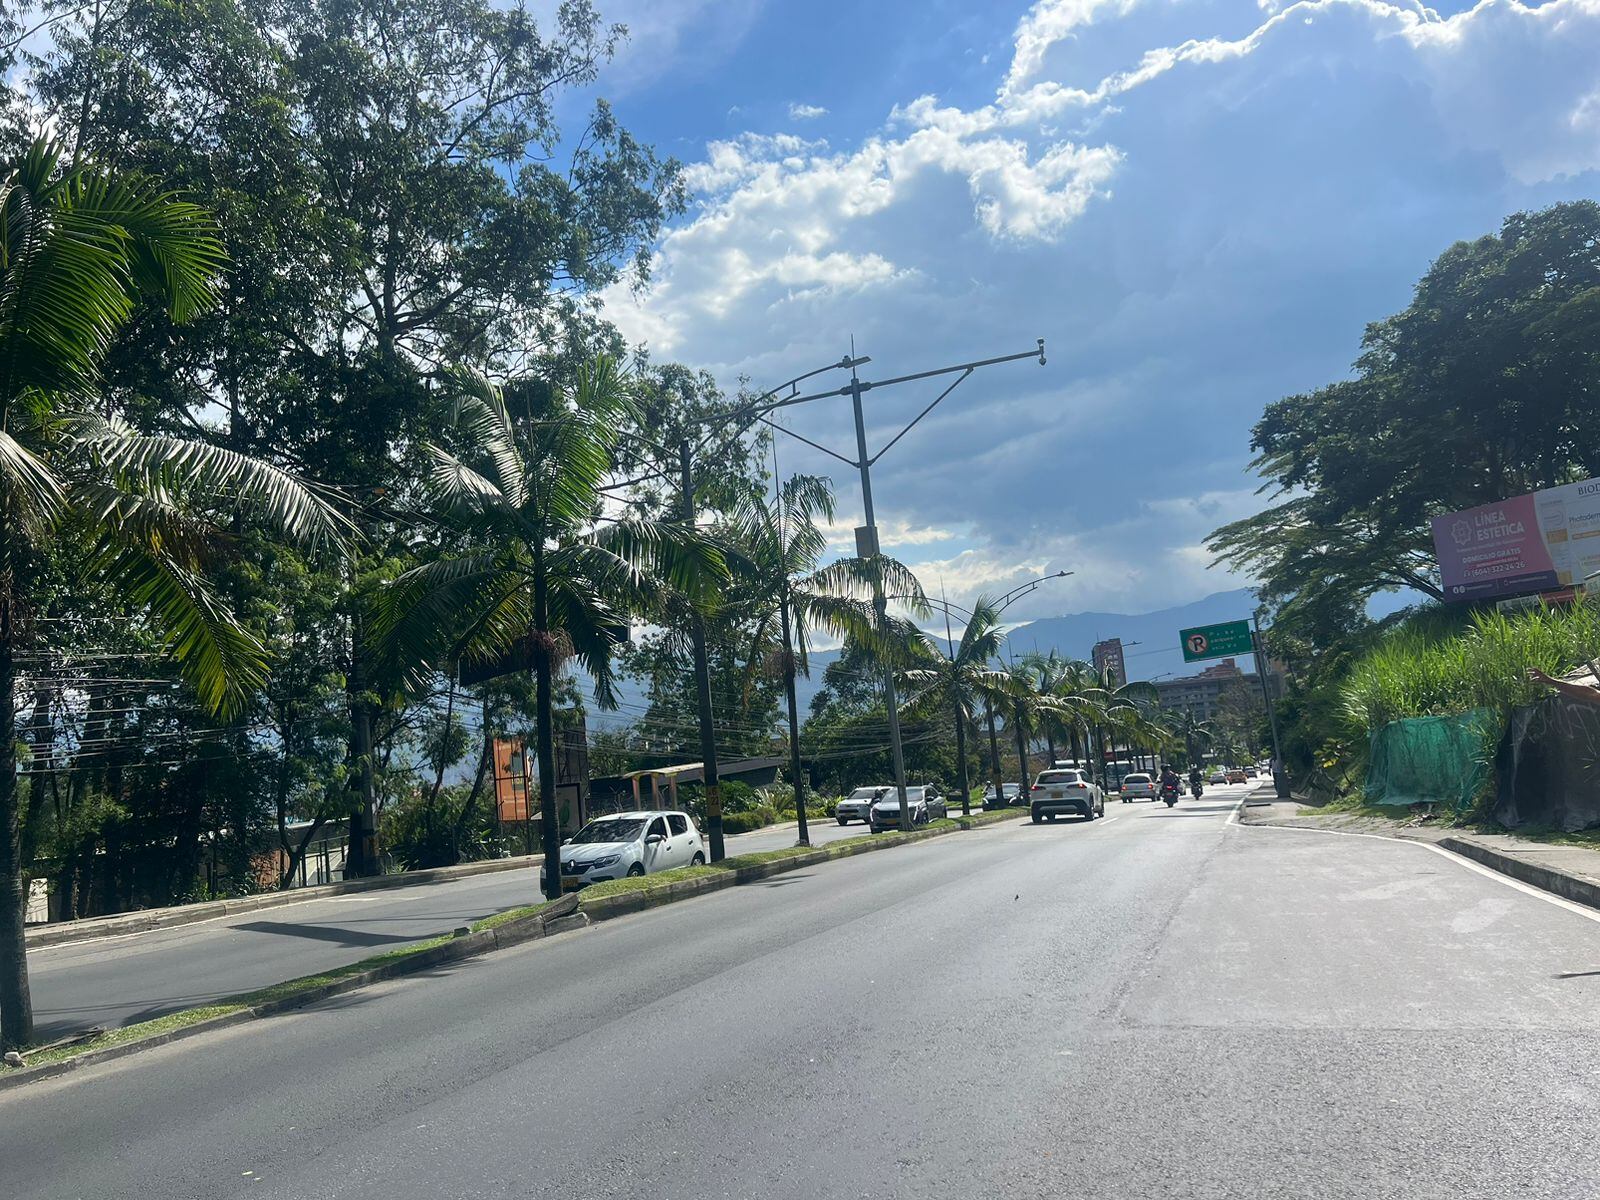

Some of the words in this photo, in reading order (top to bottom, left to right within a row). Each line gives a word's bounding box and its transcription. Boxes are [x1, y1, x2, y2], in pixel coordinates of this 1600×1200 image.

[1474, 510, 1506, 527] LÍNEA
[1476, 521, 1525, 541] ESTÉTICA
[1496, 547, 1521, 557] GRATIS
